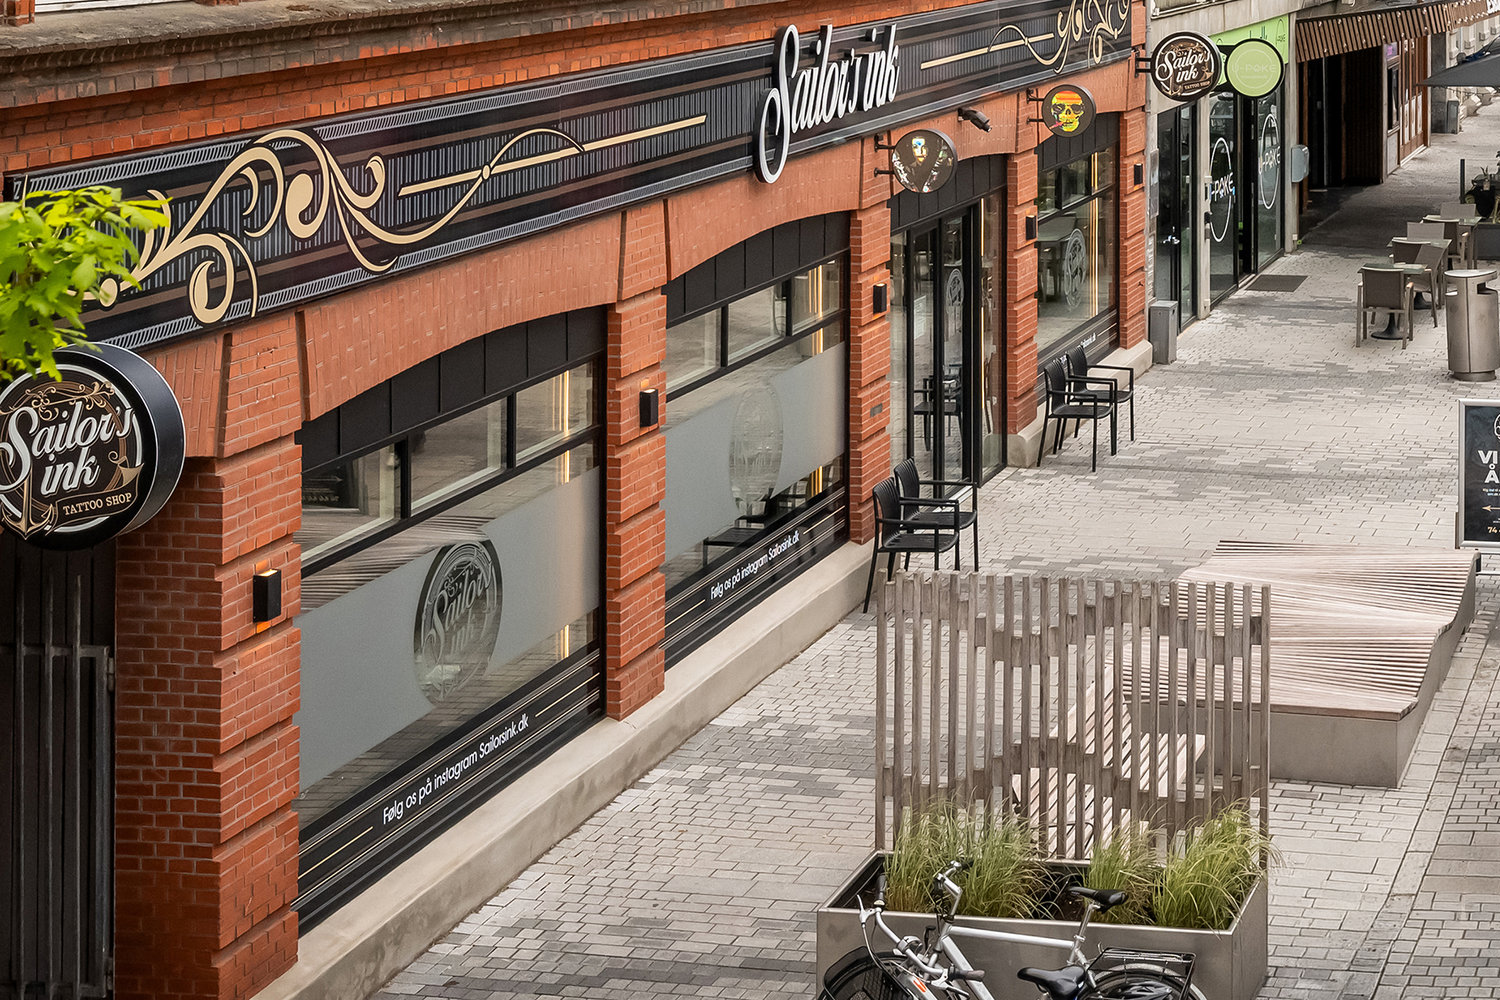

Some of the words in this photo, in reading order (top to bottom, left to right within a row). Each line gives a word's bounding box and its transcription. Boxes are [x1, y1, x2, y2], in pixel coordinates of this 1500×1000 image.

[1156, 48, 1210, 81] Sailor's
[1176, 66, 1199, 83] ink
[759, 24, 862, 184] Sailor's
[863, 24, 900, 111] ink
[0, 401, 134, 491] Sailor's
[1478, 450, 1498, 464] VI
[41, 447, 100, 496] ink
[63, 499, 103, 516] TATTOO
[105, 492, 132, 507] SHOP
[383, 800, 403, 825] Følg
[406, 792, 416, 808] os
[418, 778, 432, 805] på
[434, 751, 478, 790] instagram
[479, 713, 529, 759] Sailorsink.dk
